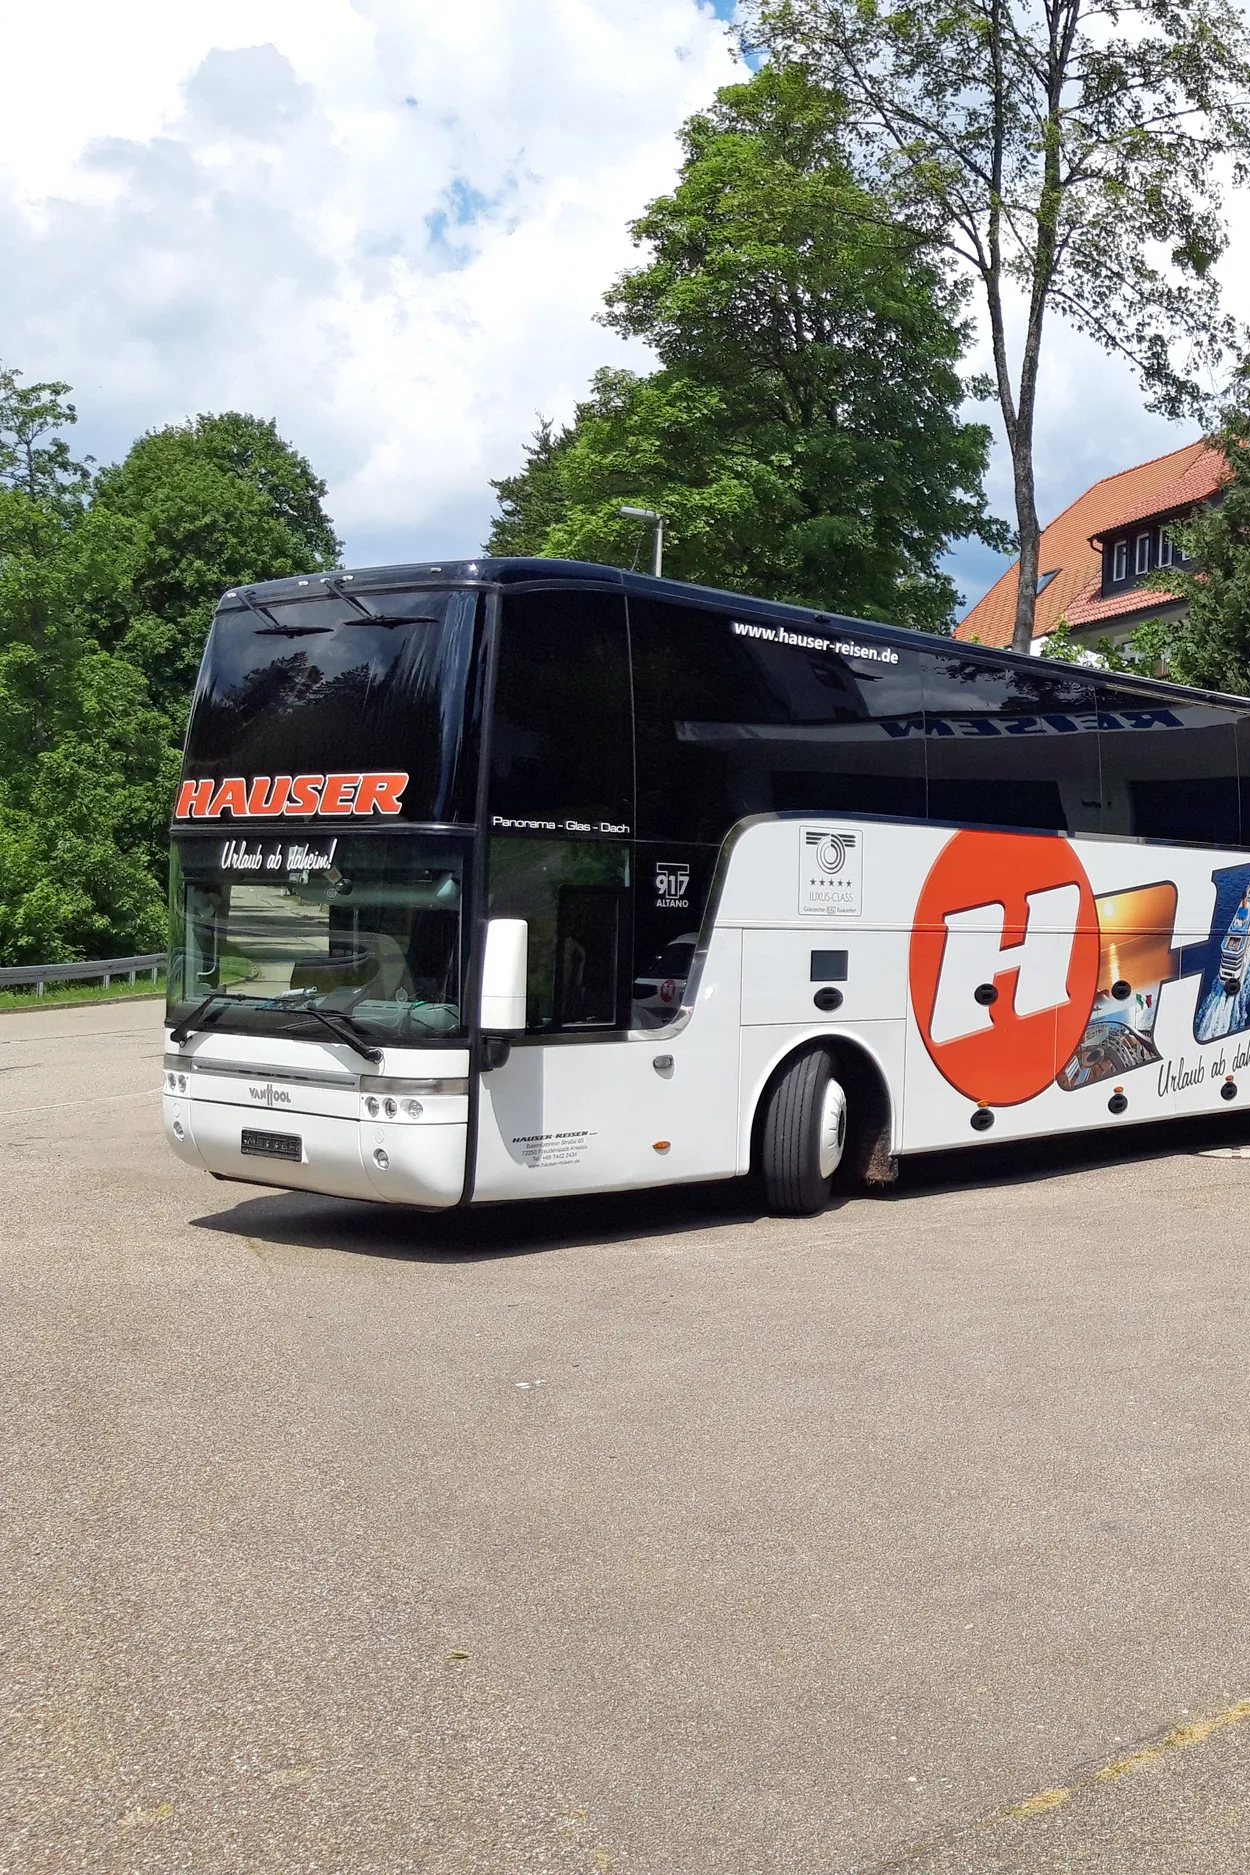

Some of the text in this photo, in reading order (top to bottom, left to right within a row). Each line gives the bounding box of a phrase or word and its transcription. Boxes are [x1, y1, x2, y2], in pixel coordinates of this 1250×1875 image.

[734, 622, 899, 664] www.hauser-reisen.de
[176, 772, 409, 819] HAUSER
[493, 816, 556, 830] Panorama
[565, 820, 591, 832] Glas
[600, 822, 630, 833] Dach
[221, 837, 338, 871] Urlaub ab daheim!
[656, 899, 689, 908] ALTANO
[809, 891, 854, 902] LUXUS-CLASS
[1157, 1055, 1205, 1098] Urlaub
[1211, 1048, 1226, 1079] ab
